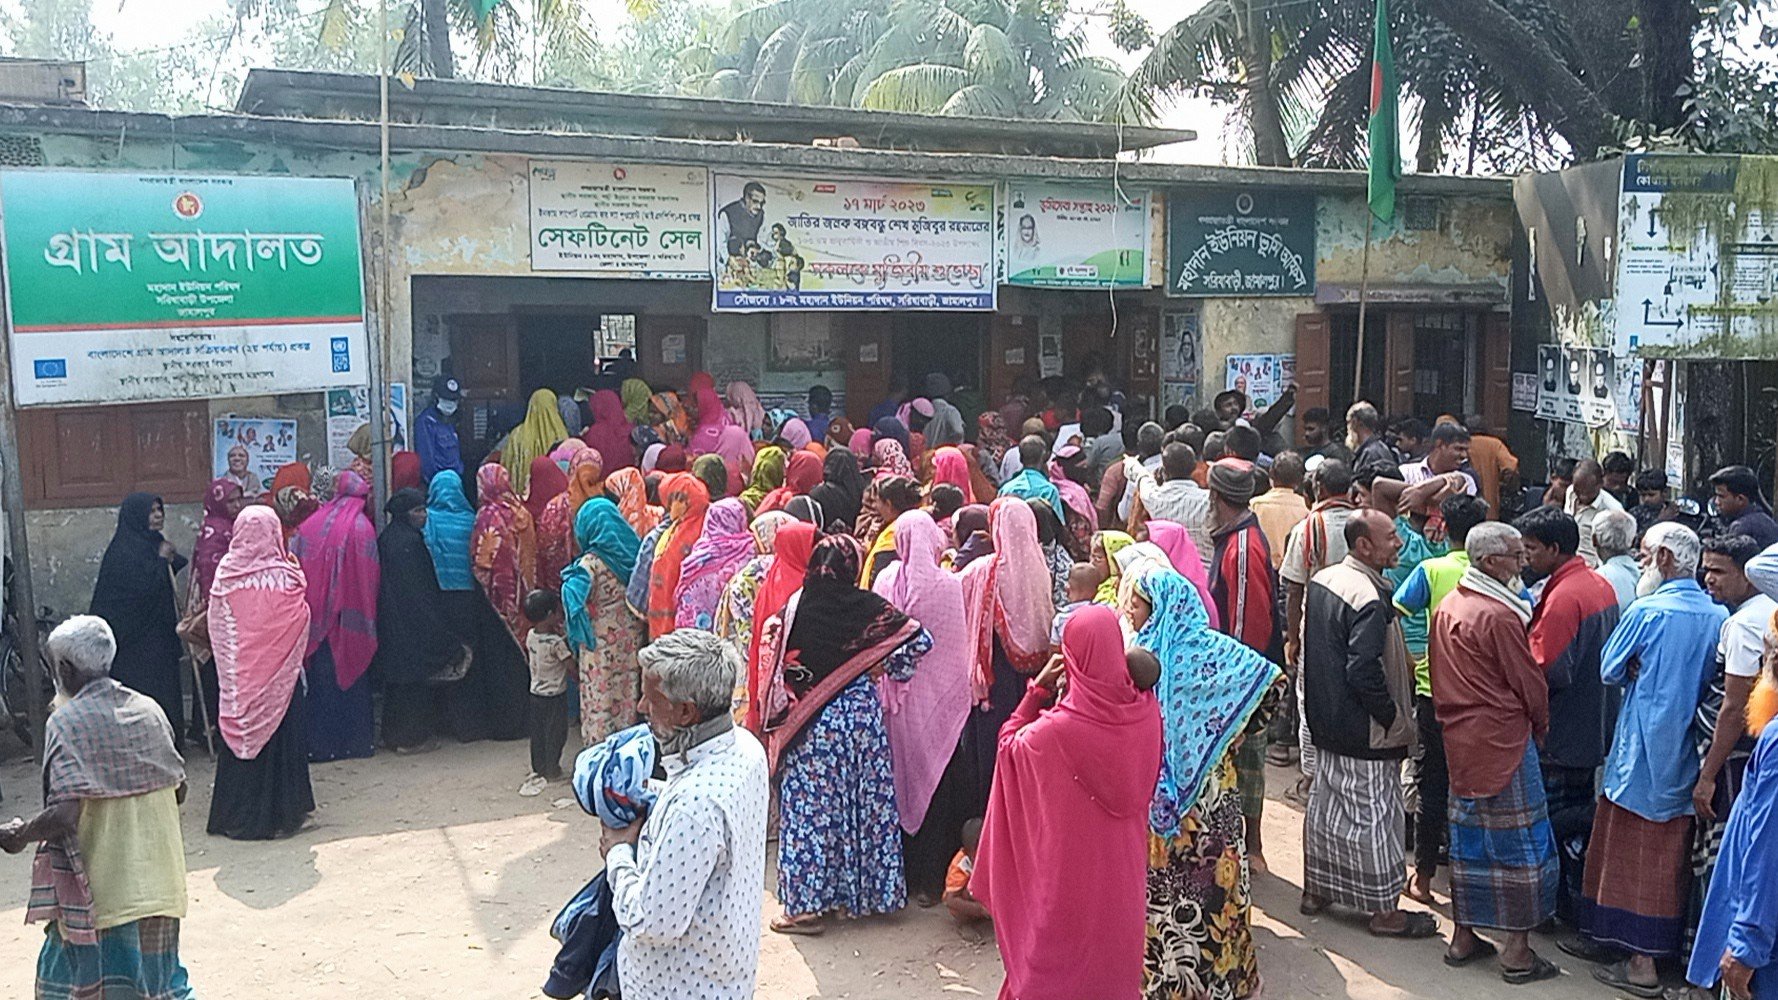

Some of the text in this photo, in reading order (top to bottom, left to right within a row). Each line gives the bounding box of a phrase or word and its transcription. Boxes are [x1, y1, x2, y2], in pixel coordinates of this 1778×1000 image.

[844, 194, 926, 213] ১৭ মার্চ ২০২৩
[538, 222, 703, 250] সেফটিনেট সেল
[787, 212, 990, 234] জাতির জনক বঙ্গবন্ধু শেখ মুজিবুর রহমানের
[44, 226, 324, 275] গ্রাম আদালত
[1177, 226, 1306, 290] মহাদান ইউনিয়ন ভূমি অফিস
